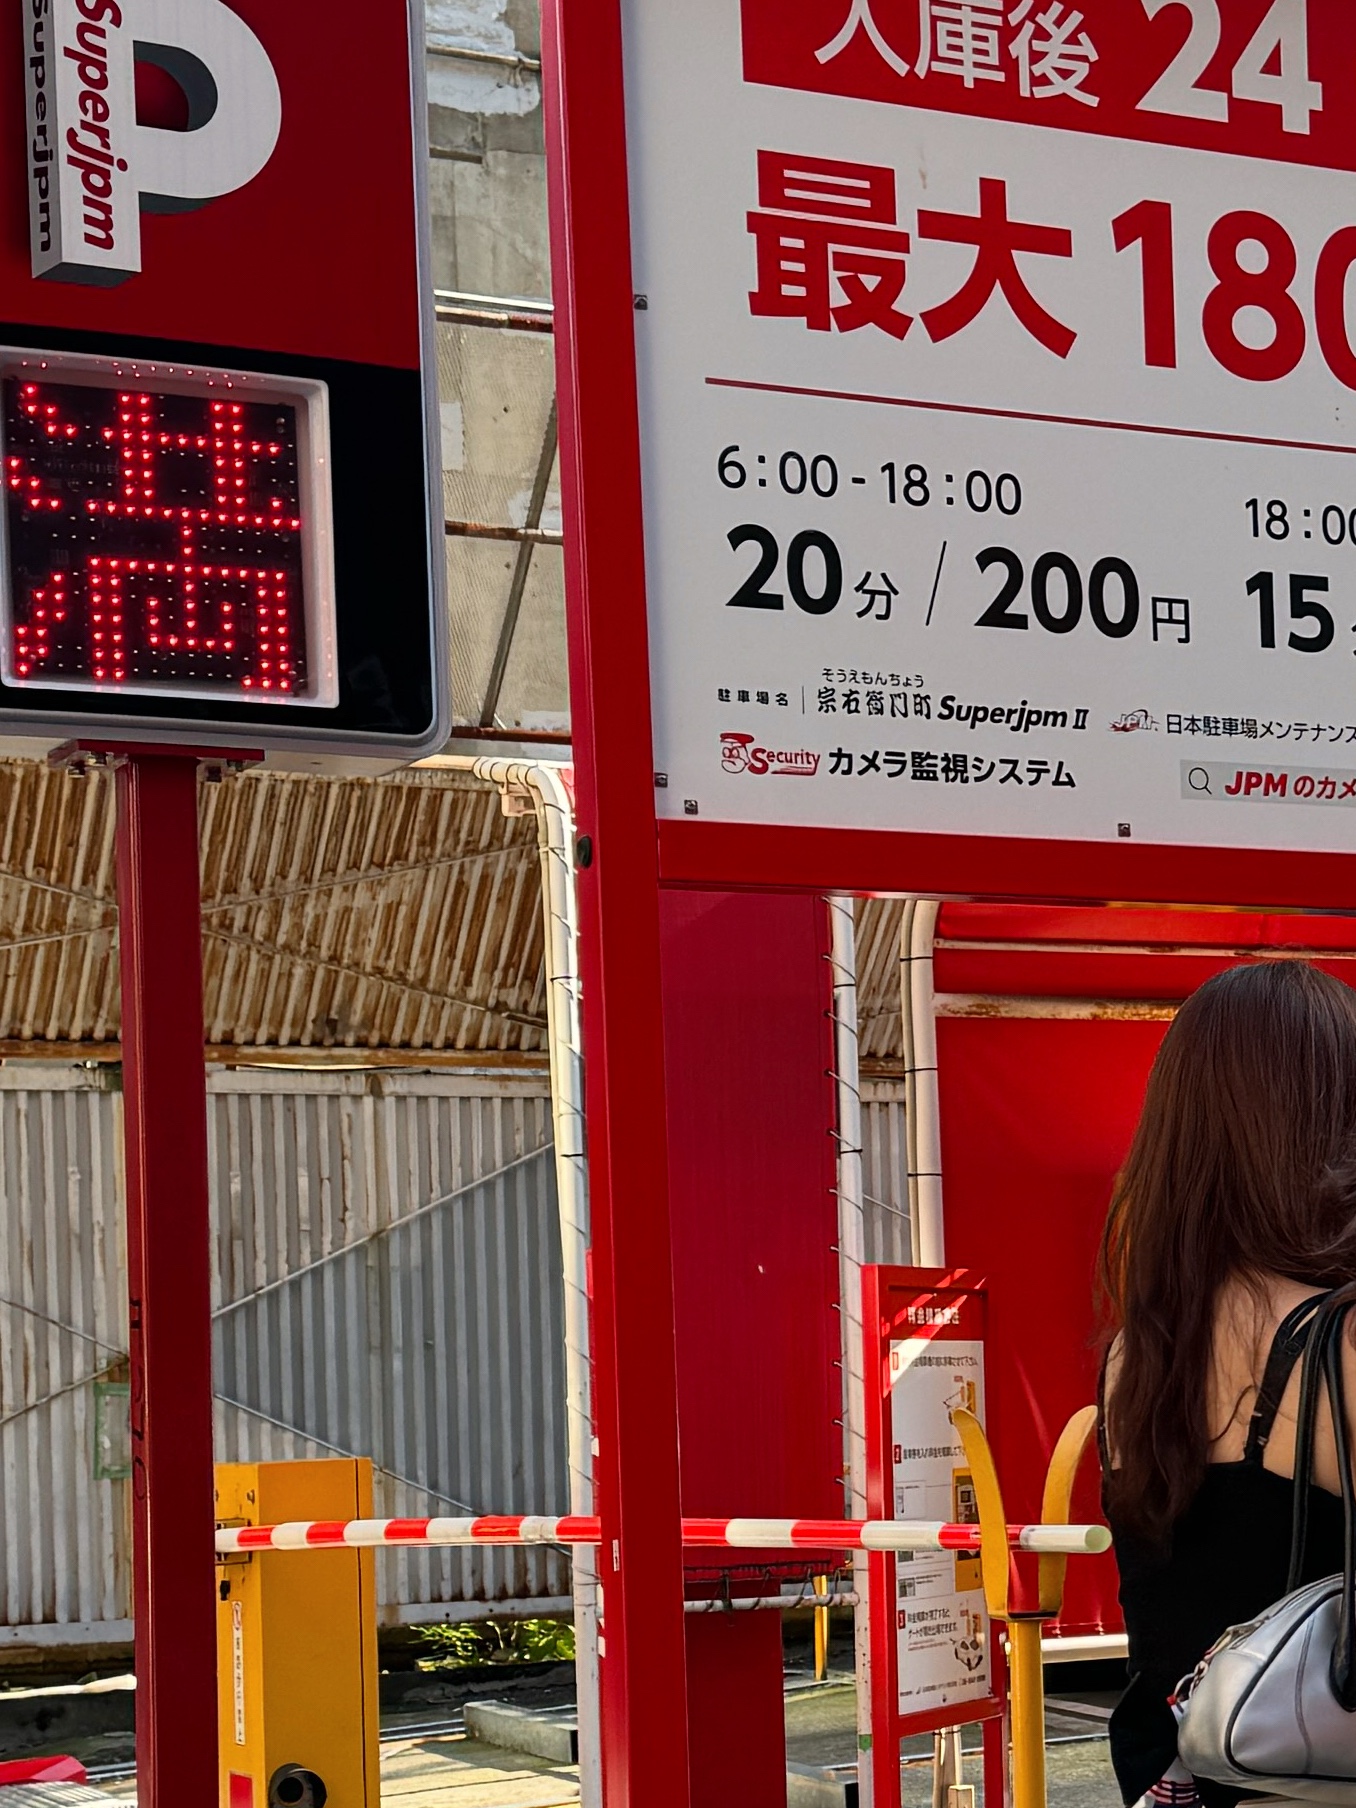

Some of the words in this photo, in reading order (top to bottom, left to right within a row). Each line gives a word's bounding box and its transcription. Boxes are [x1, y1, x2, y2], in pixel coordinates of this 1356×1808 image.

[1136, 0, 1322, 135] 24
[4, 383, 301, 691] 満
[718, 689, 788, 706] 駐車場名
[822, 668, 924, 687] そうえもんちょう
[829, 747, 1076, 788] カメラ監視システム
